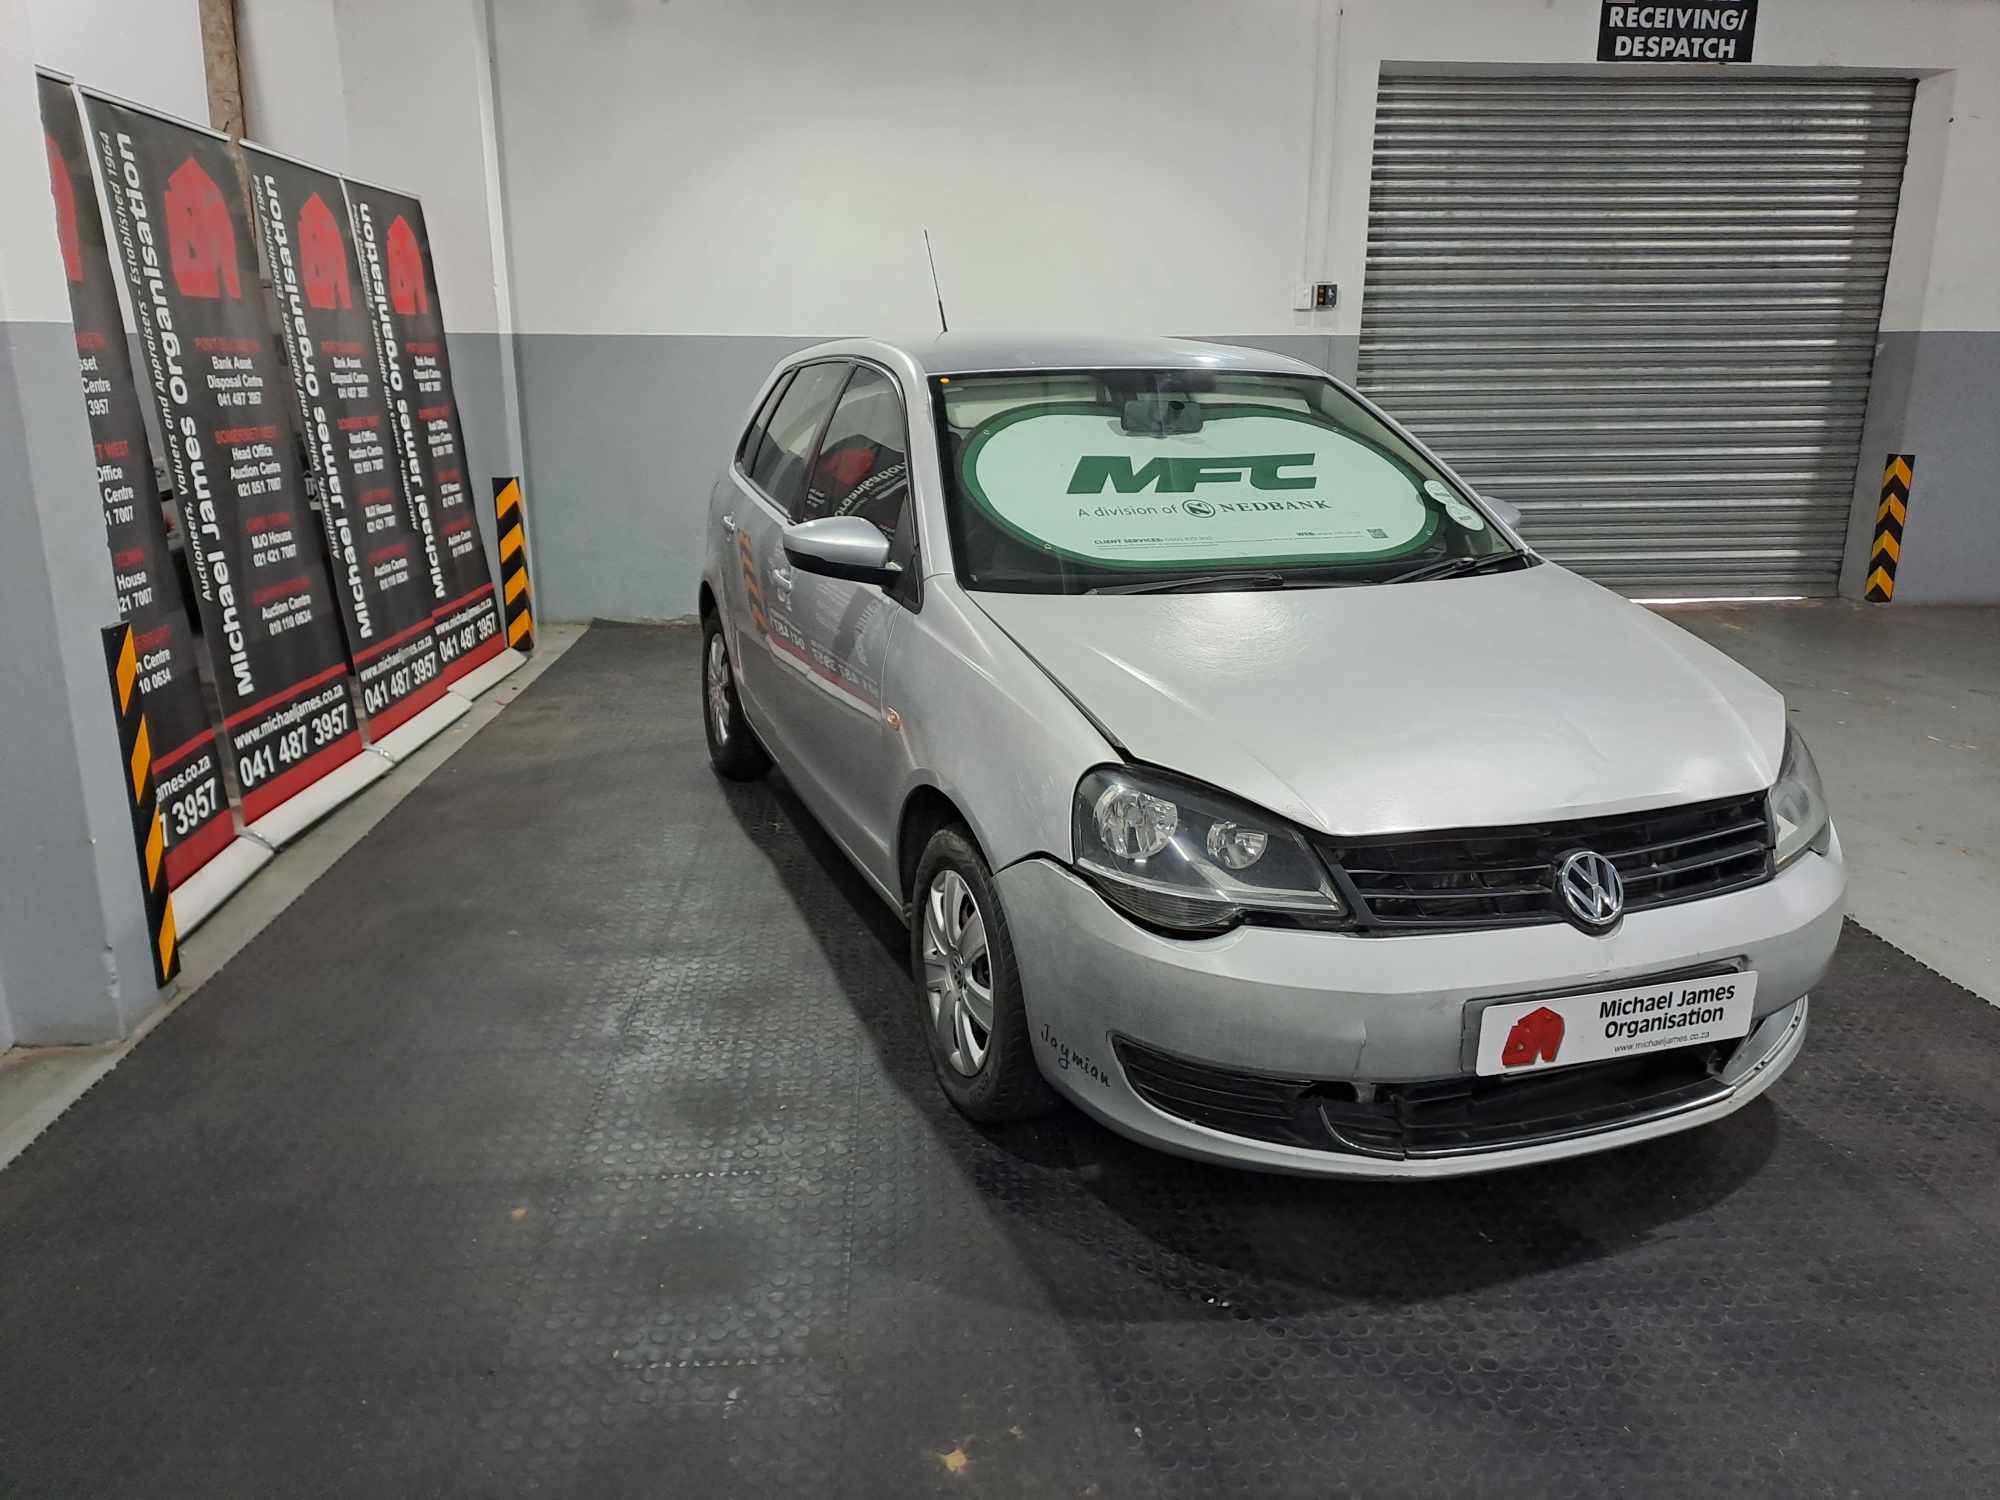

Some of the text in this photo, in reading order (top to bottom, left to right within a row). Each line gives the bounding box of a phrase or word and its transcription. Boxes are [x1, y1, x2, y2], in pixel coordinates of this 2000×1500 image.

[1609, 6, 1748, 31] RECEIVING/
[1614, 35, 1736, 59] DESPATCH
[108, 181, 141, 285] Established
[264, 174, 319, 397] Organisation
[359, 202, 403, 391] Organisation
[139, 301, 166, 393] Appraisers
[81, 377, 111, 393] Centre
[88, 399, 109, 416] 3957
[117, 132, 255, 697] Michael James Organisation
[158, 396, 173, 429] and
[169, 434, 188, 495] Valuers
[313, 406, 345, 509] James
[397, 399, 423, 488] James
[230, 464, 260, 480] Auction
[1066, 453, 1318, 495] MFC
[104, 486, 134, 503] Centre
[113, 505, 134, 523] 7007
[1077, 504, 1178, 519] A division of
[1218, 500, 1333, 514] NEDBANK
[415, 495, 446, 599] Michael
[117, 571, 147, 591] House
[132, 588, 153, 608] 7007
[335, 518, 372, 639] Michael
[439, 612, 497, 662] 041 487 3957
[143, 649, 171, 670] Centre
[364, 651, 437, 713] 041 487 3957
[234, 684, 344, 750] www.michaeljames.co.za
[239, 703, 349, 787] 041 487 3957
[172, 777, 217, 835] 3957
[1600, 984, 1735, 1019] Michael James
[1605, 1006, 1724, 1039] Organisation
